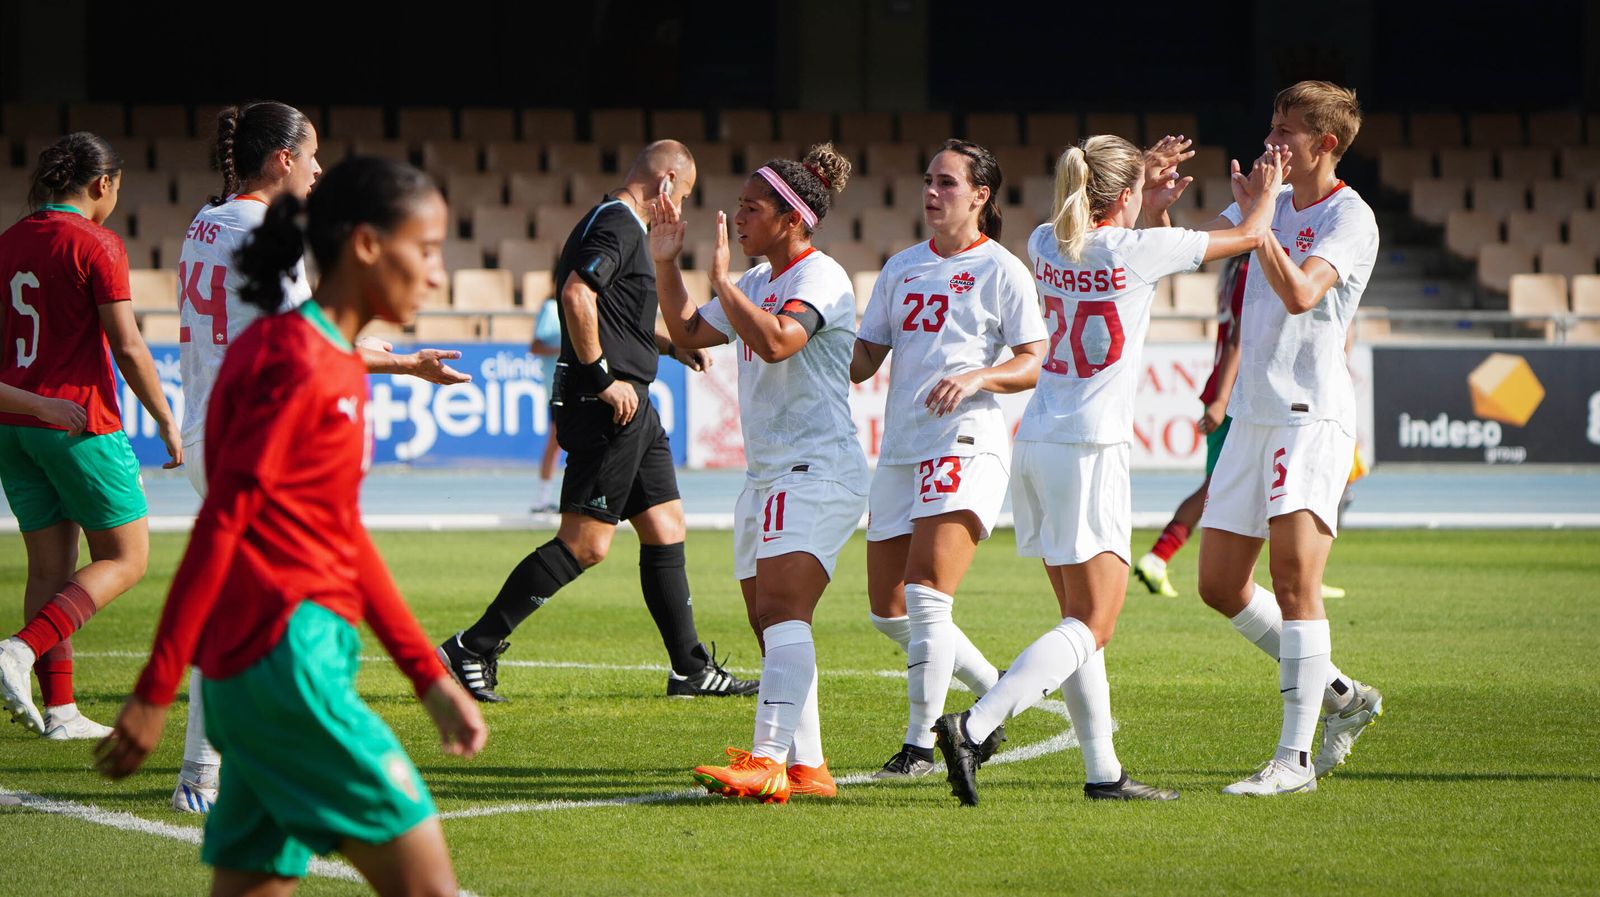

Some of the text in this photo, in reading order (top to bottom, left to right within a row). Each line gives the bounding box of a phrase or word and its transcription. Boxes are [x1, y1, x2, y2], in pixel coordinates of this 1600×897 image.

[949, 279, 975, 287] CANADA
[1035, 256, 1127, 292] LACASSE
[902, 292, 949, 333] 23
[1041, 294, 1126, 379] 20
[1398, 412, 1502, 448] indeso
[919, 455, 962, 495] 23
[1271, 447, 1288, 490] 5
[1483, 446, 1527, 464] group
[763, 491, 787, 532] 11
